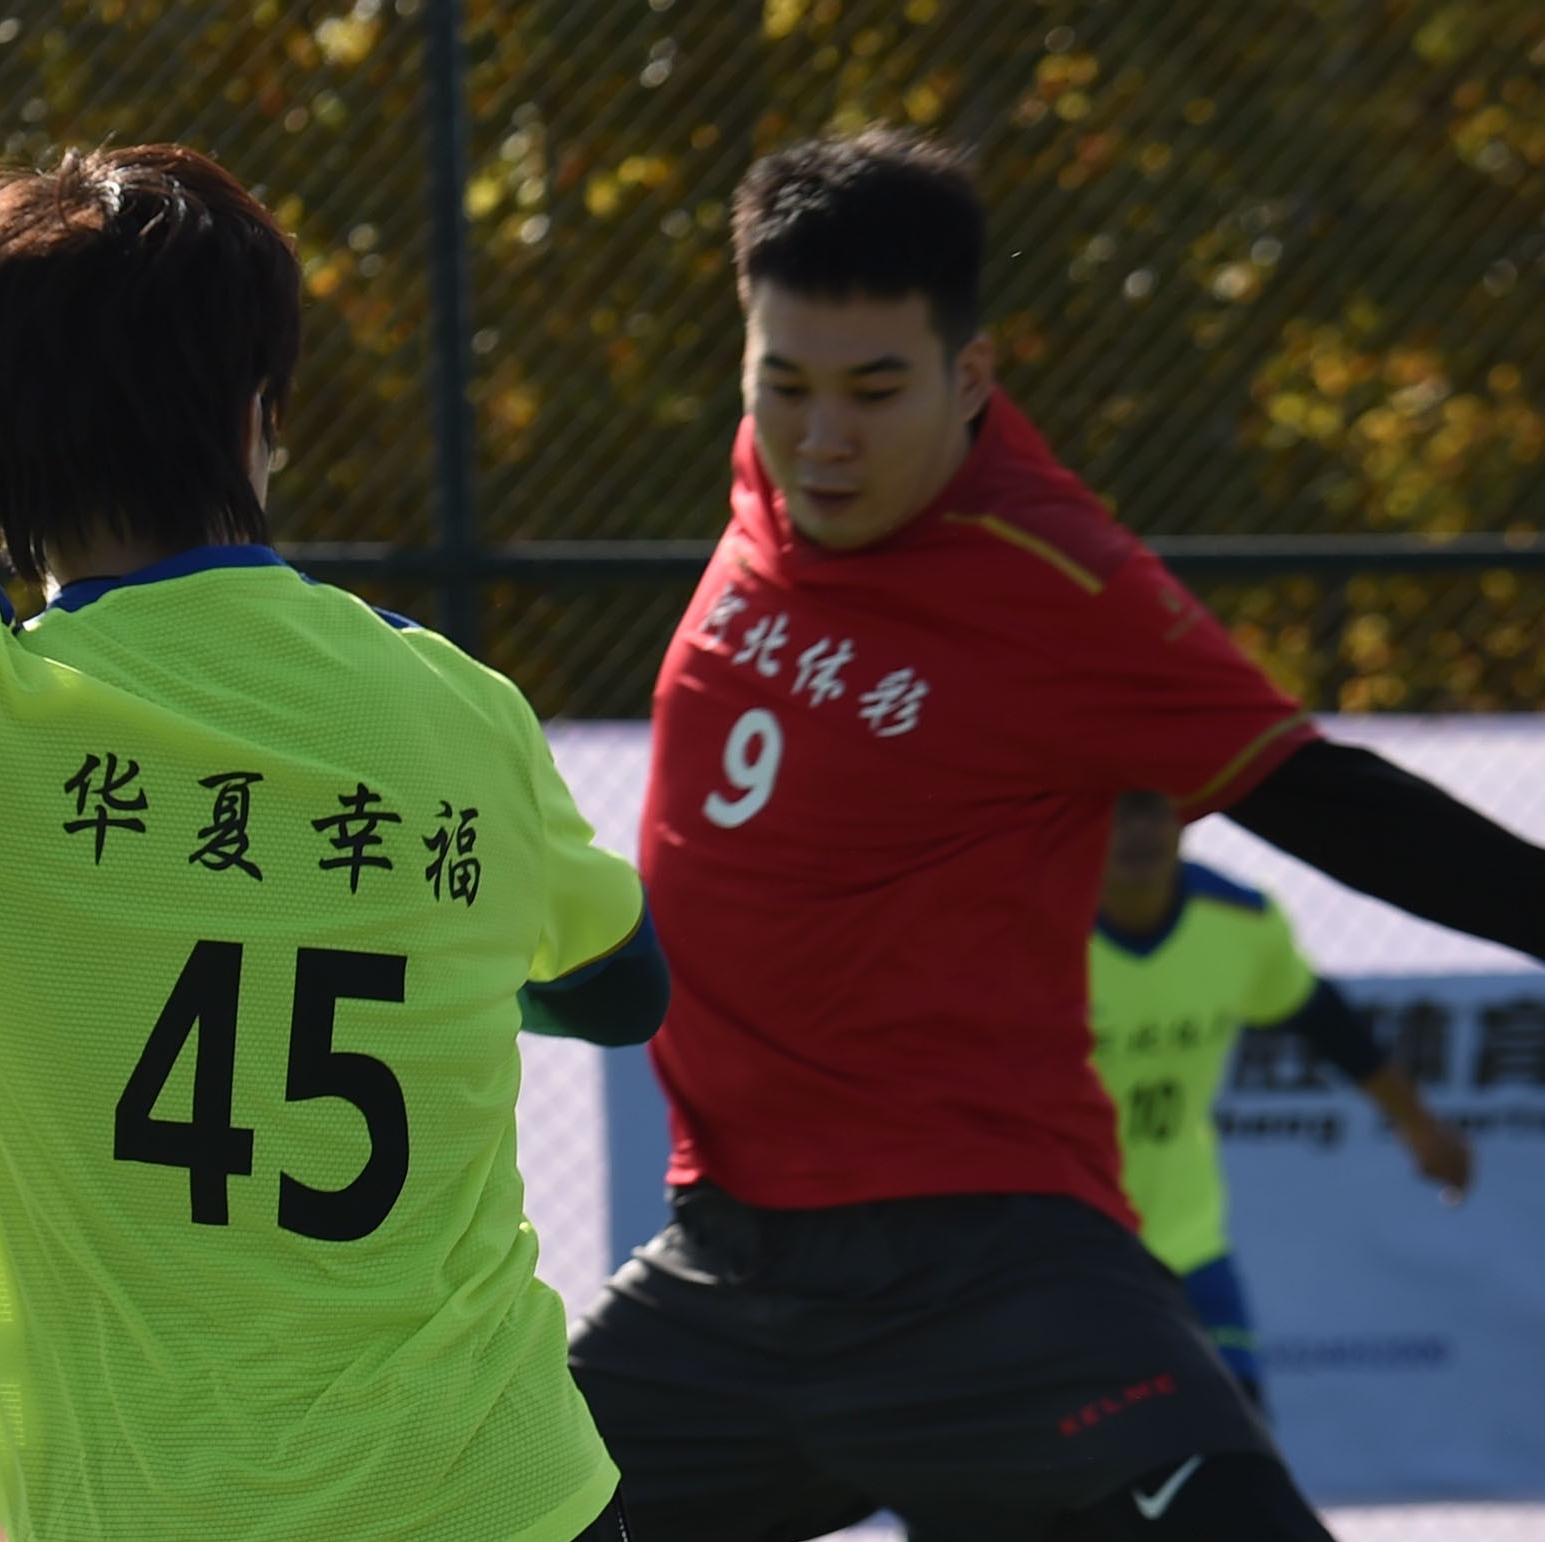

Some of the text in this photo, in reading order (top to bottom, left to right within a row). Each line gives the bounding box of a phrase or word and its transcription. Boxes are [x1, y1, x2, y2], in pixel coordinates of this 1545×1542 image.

[62, 751, 483, 908] 华夏幸福
[702, 707, 784, 829] 9
[112, 938, 411, 1243] 45
